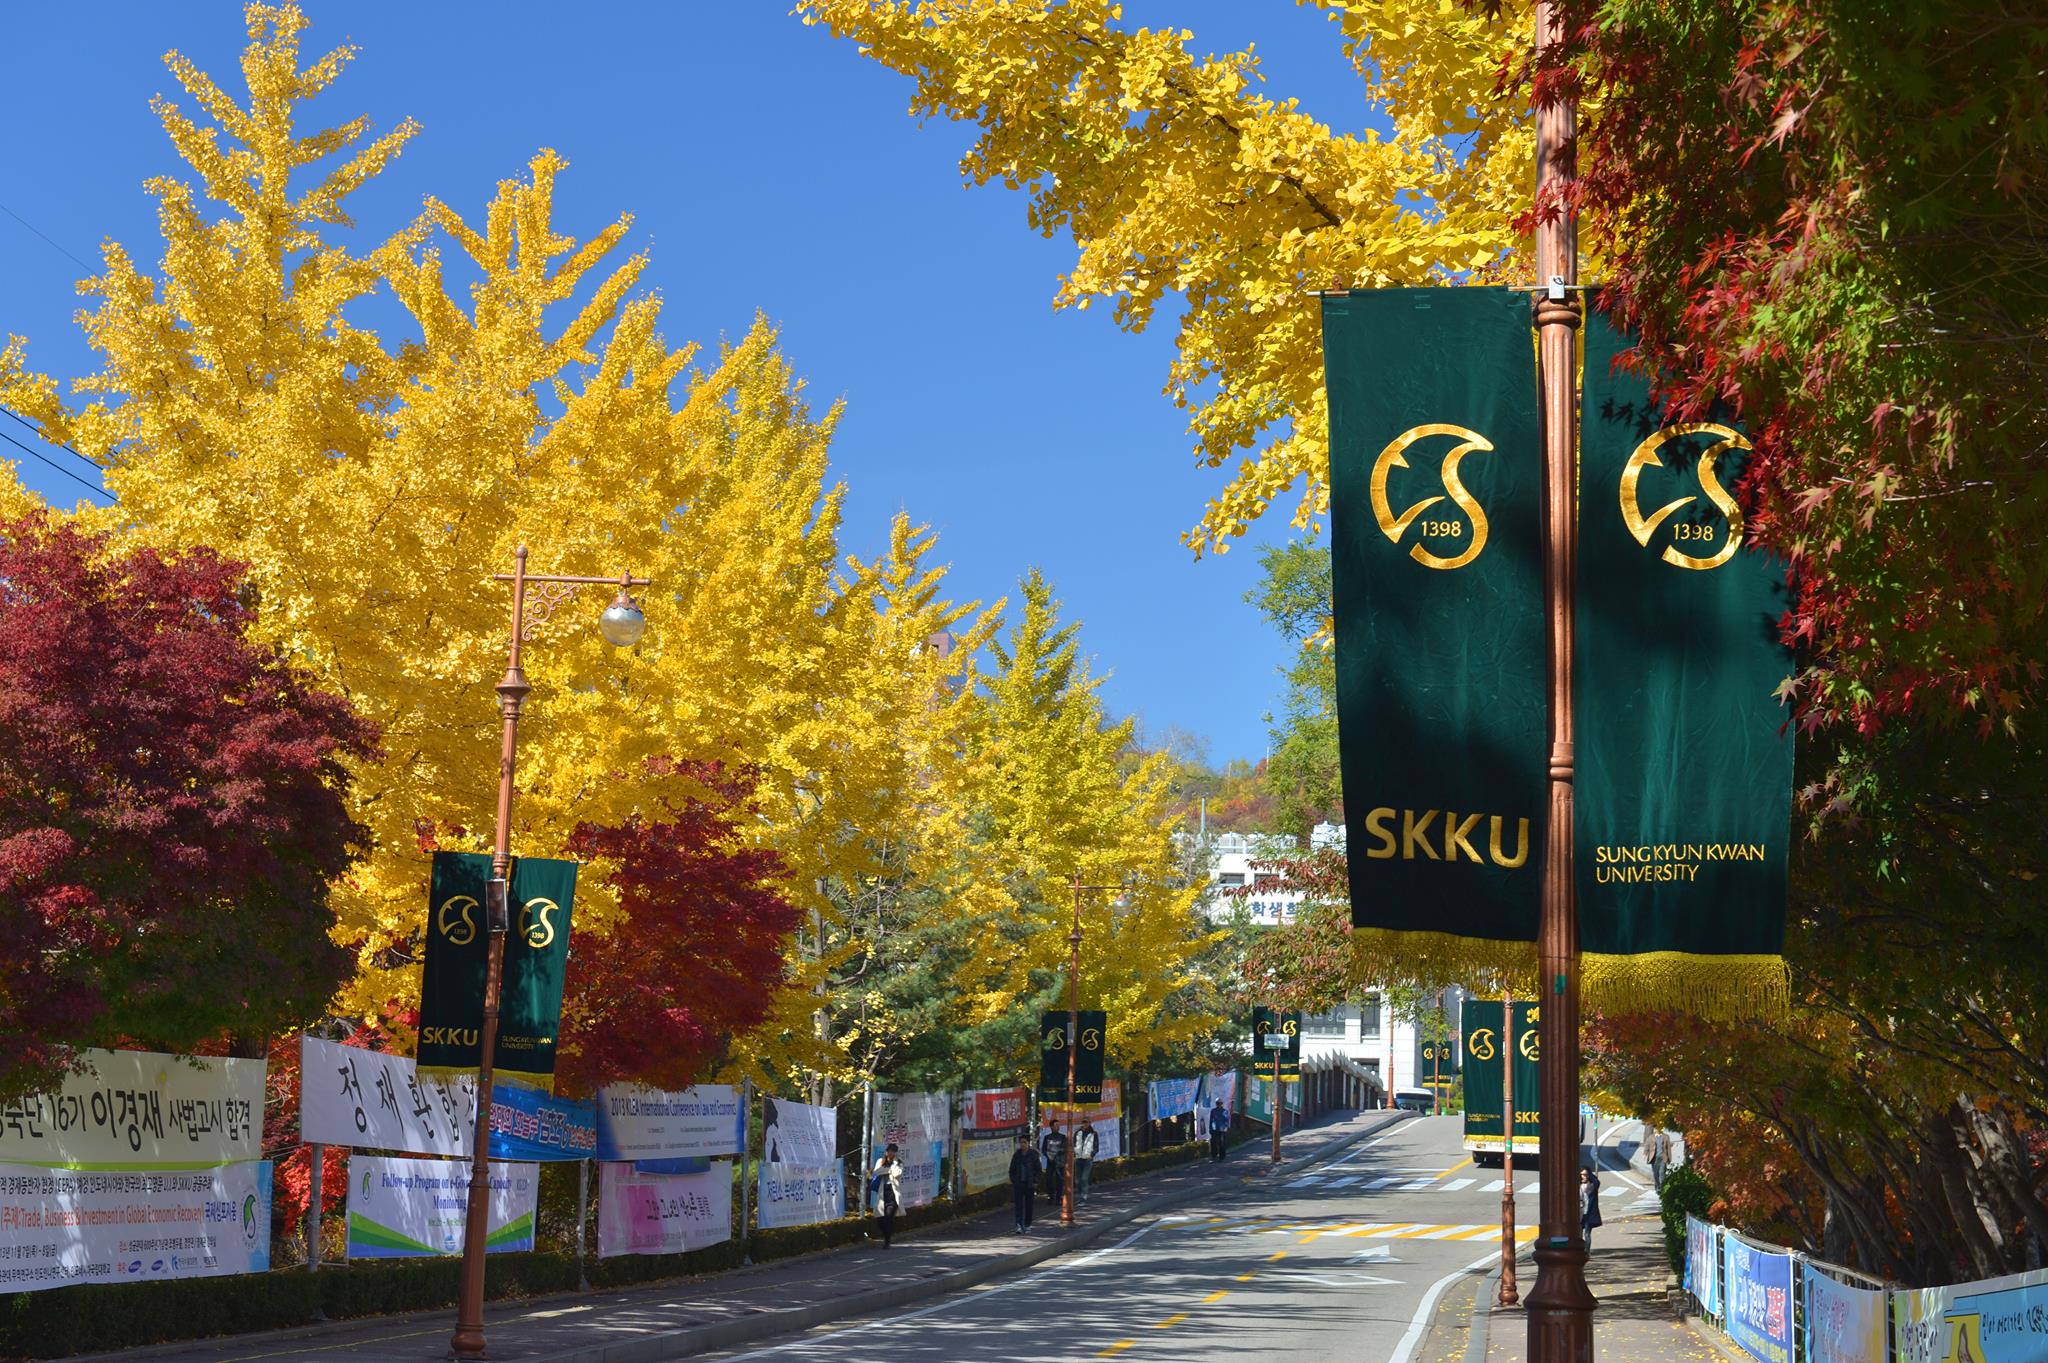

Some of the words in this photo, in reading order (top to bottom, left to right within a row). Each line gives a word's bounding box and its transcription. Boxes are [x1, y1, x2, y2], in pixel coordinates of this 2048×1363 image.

[1421, 520, 1462, 537] 1398
[1673, 523, 1715, 541] 1398
[1365, 807, 1530, 868] SKKU
[1596, 865, 1700, 883] UNIVERSITY
[531, 931, 545, 940] 1398
[423, 1026, 479, 1046] SKKU
[1254, 1062, 1274, 1070] SKKU
[1075, 1084, 1101, 1094] SKKU
[641, 1098, 669, 1117] International
[669, 1099, 695, 1117] Conference
[48, 1094, 86, 1132] 16기
[91, 1088, 164, 1152] 이경재
[169, 1098, 223, 1142] 사법고시
[226, 1097, 250, 1142] 합격
[1515, 1111, 1540, 1123] SKK
[382, 1173, 413, 1192] Follow-up
[414, 1174, 441, 1192] Program
[441, 1179, 449, 1189] on
[433, 1195, 467, 1212] Monitoring
[45, 1206, 75, 1227] Business
[82, 1206, 118, 1226] Investment
[127, 1204, 146, 1224] Global
[147, 1203, 177, 1224] Economic
